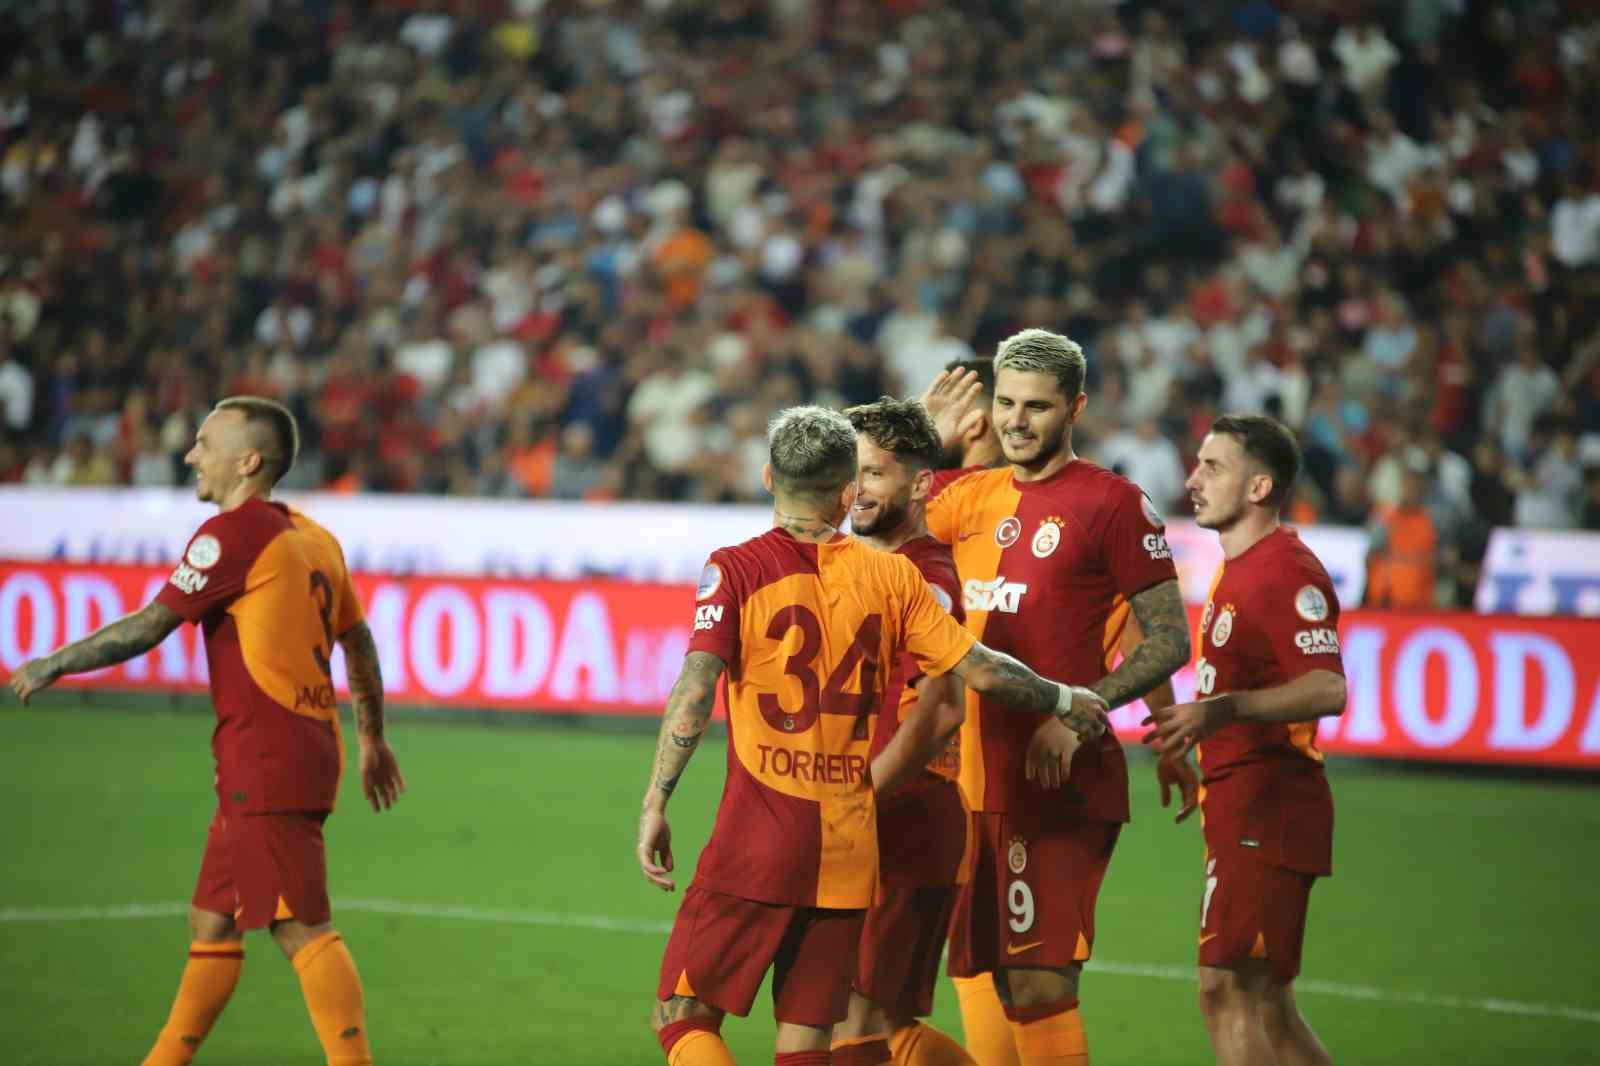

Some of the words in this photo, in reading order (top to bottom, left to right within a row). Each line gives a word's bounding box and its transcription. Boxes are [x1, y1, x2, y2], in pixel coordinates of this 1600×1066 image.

[308, 569, 333, 677] 3
[757, 604, 883, 741] 34
[1008, 880, 1035, 933] 9
